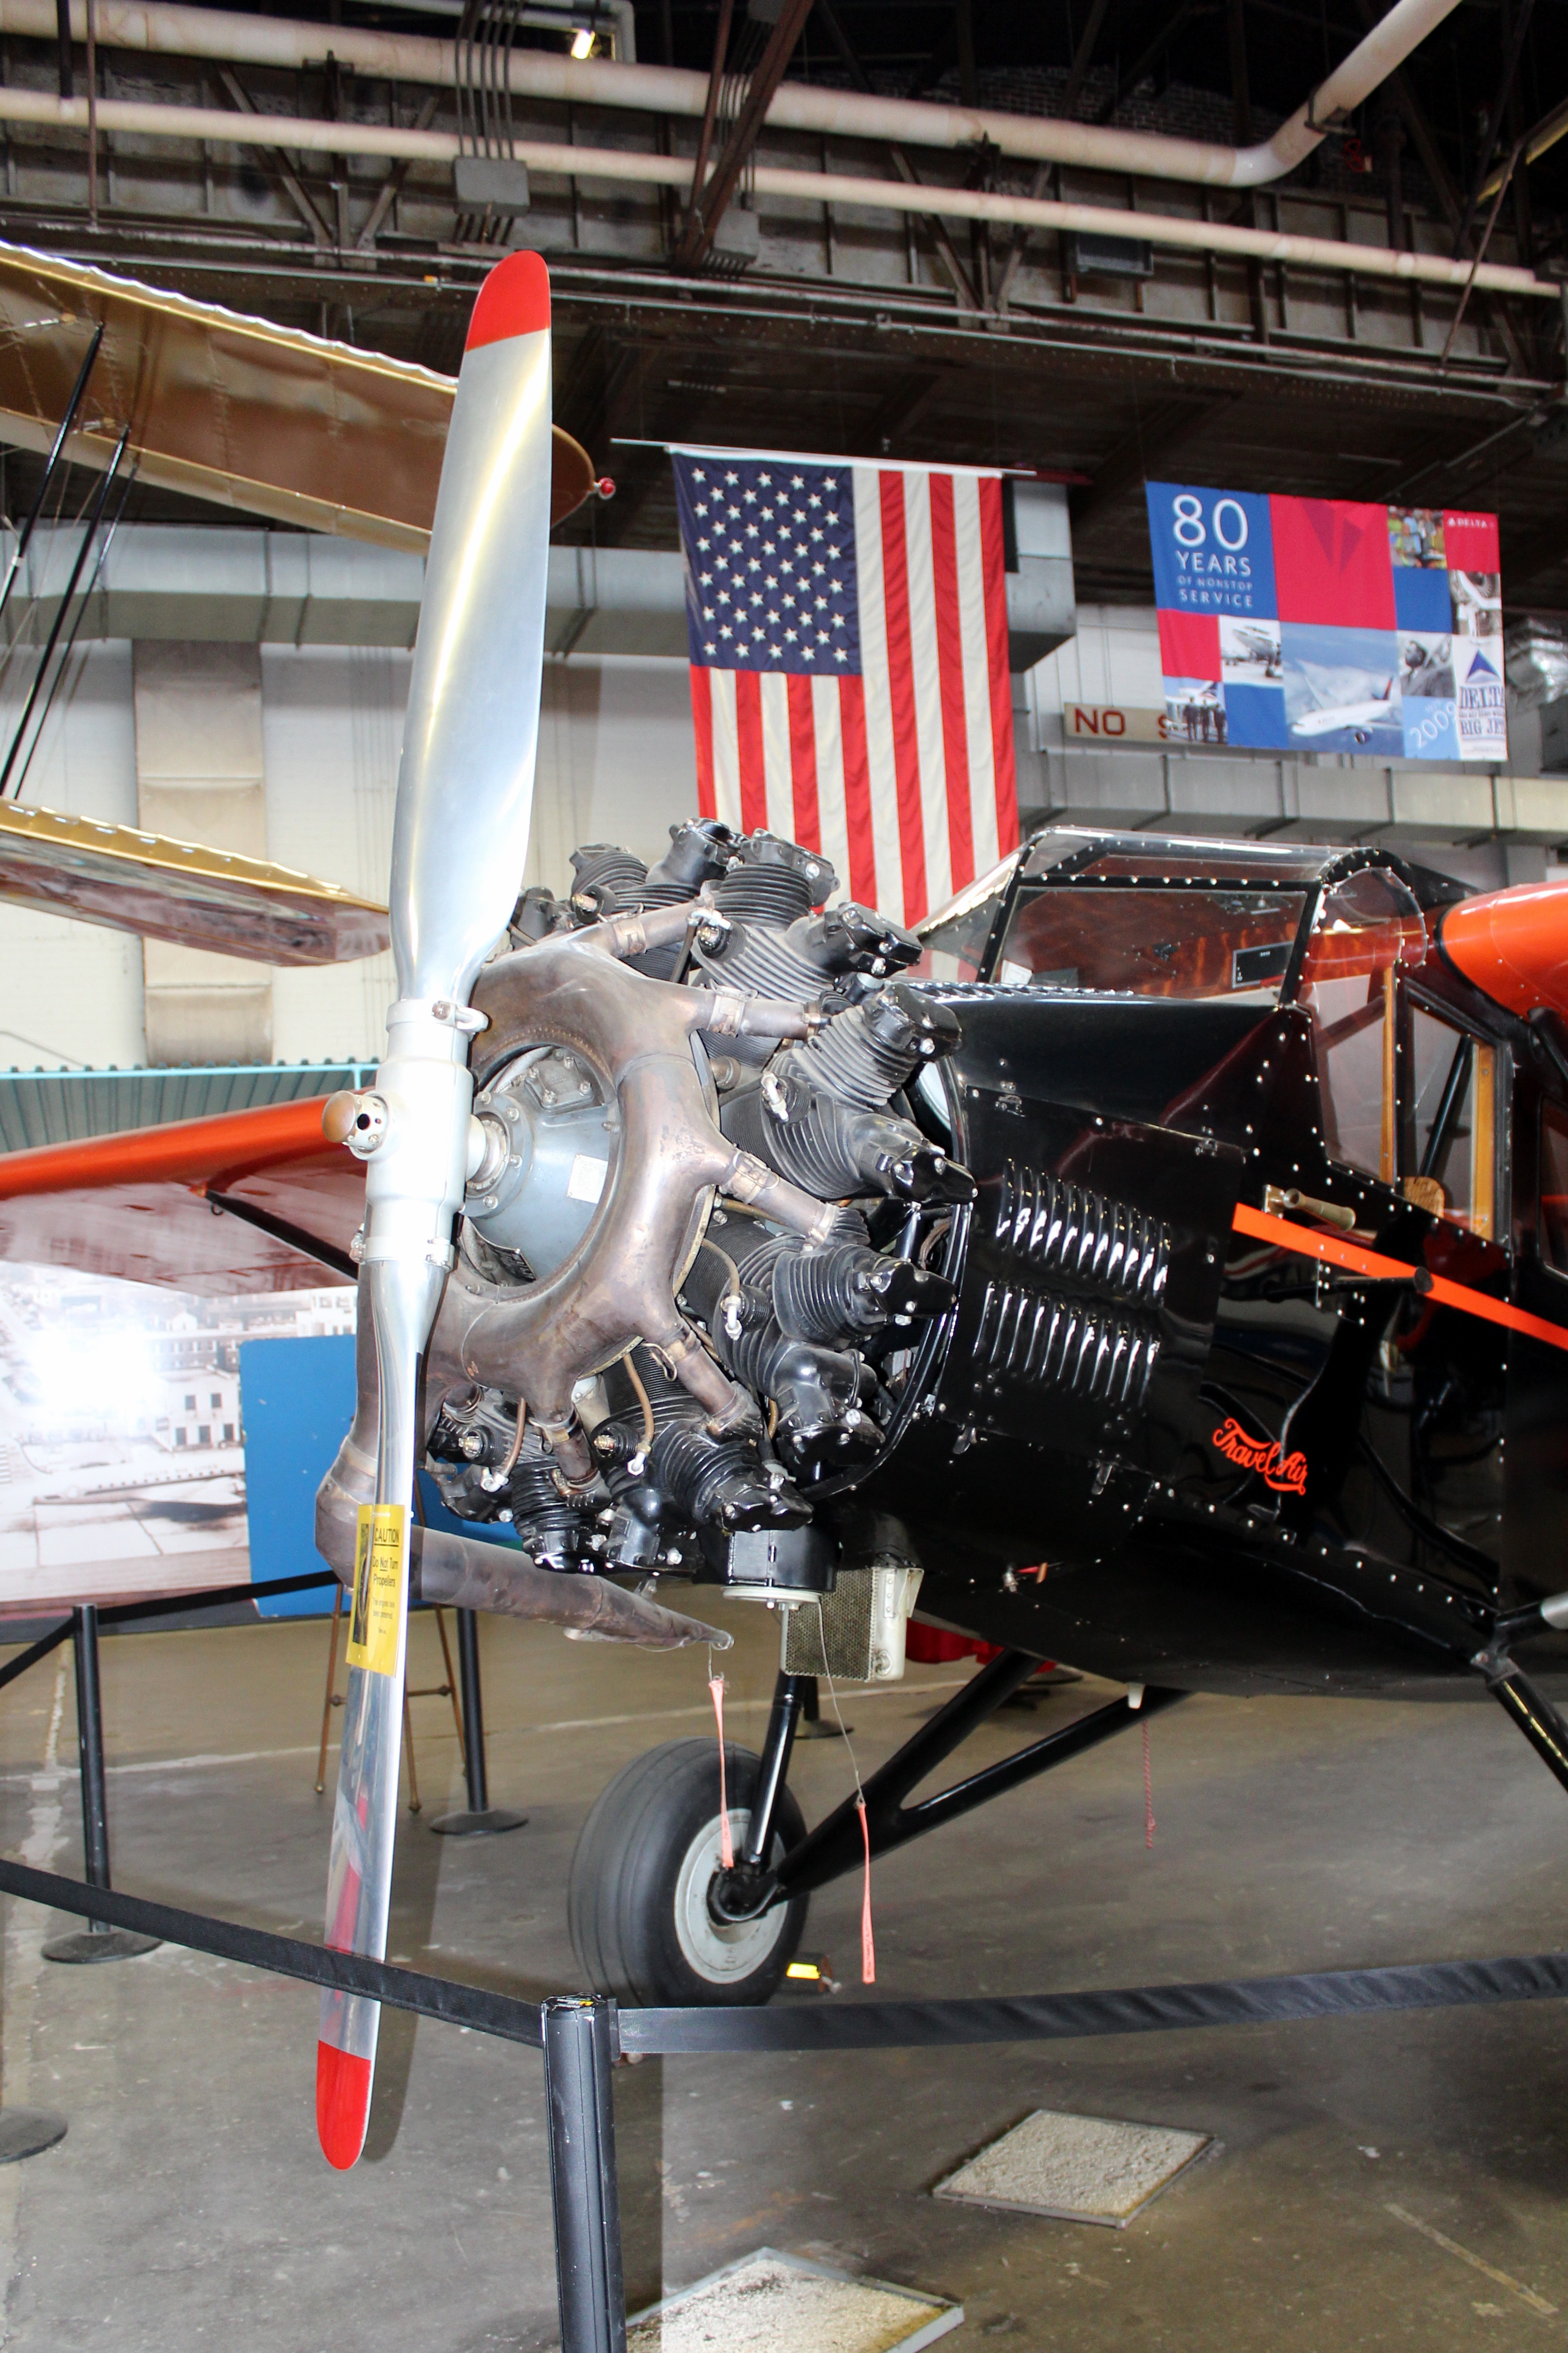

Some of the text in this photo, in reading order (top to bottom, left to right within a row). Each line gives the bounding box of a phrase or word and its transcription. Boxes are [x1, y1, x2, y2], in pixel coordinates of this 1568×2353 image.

[1172, 493, 1248, 552] 80
[1457, 517, 1488, 529] DELTA
[1175, 550, 1251, 578] YEARS
[1196, 577, 1253, 592] NONSTOP
[1179, 588, 1253, 608] SERVICE
[1074, 708, 1125, 736] NO
[1212, 1417, 1308, 1495] Travel Air
[374, 1527, 399, 1543] CAUTION
[372, 1555, 379, 1567] Do
[379, 1556, 388, 1569] Not
[373, 1574, 396, 1588] Propellers
